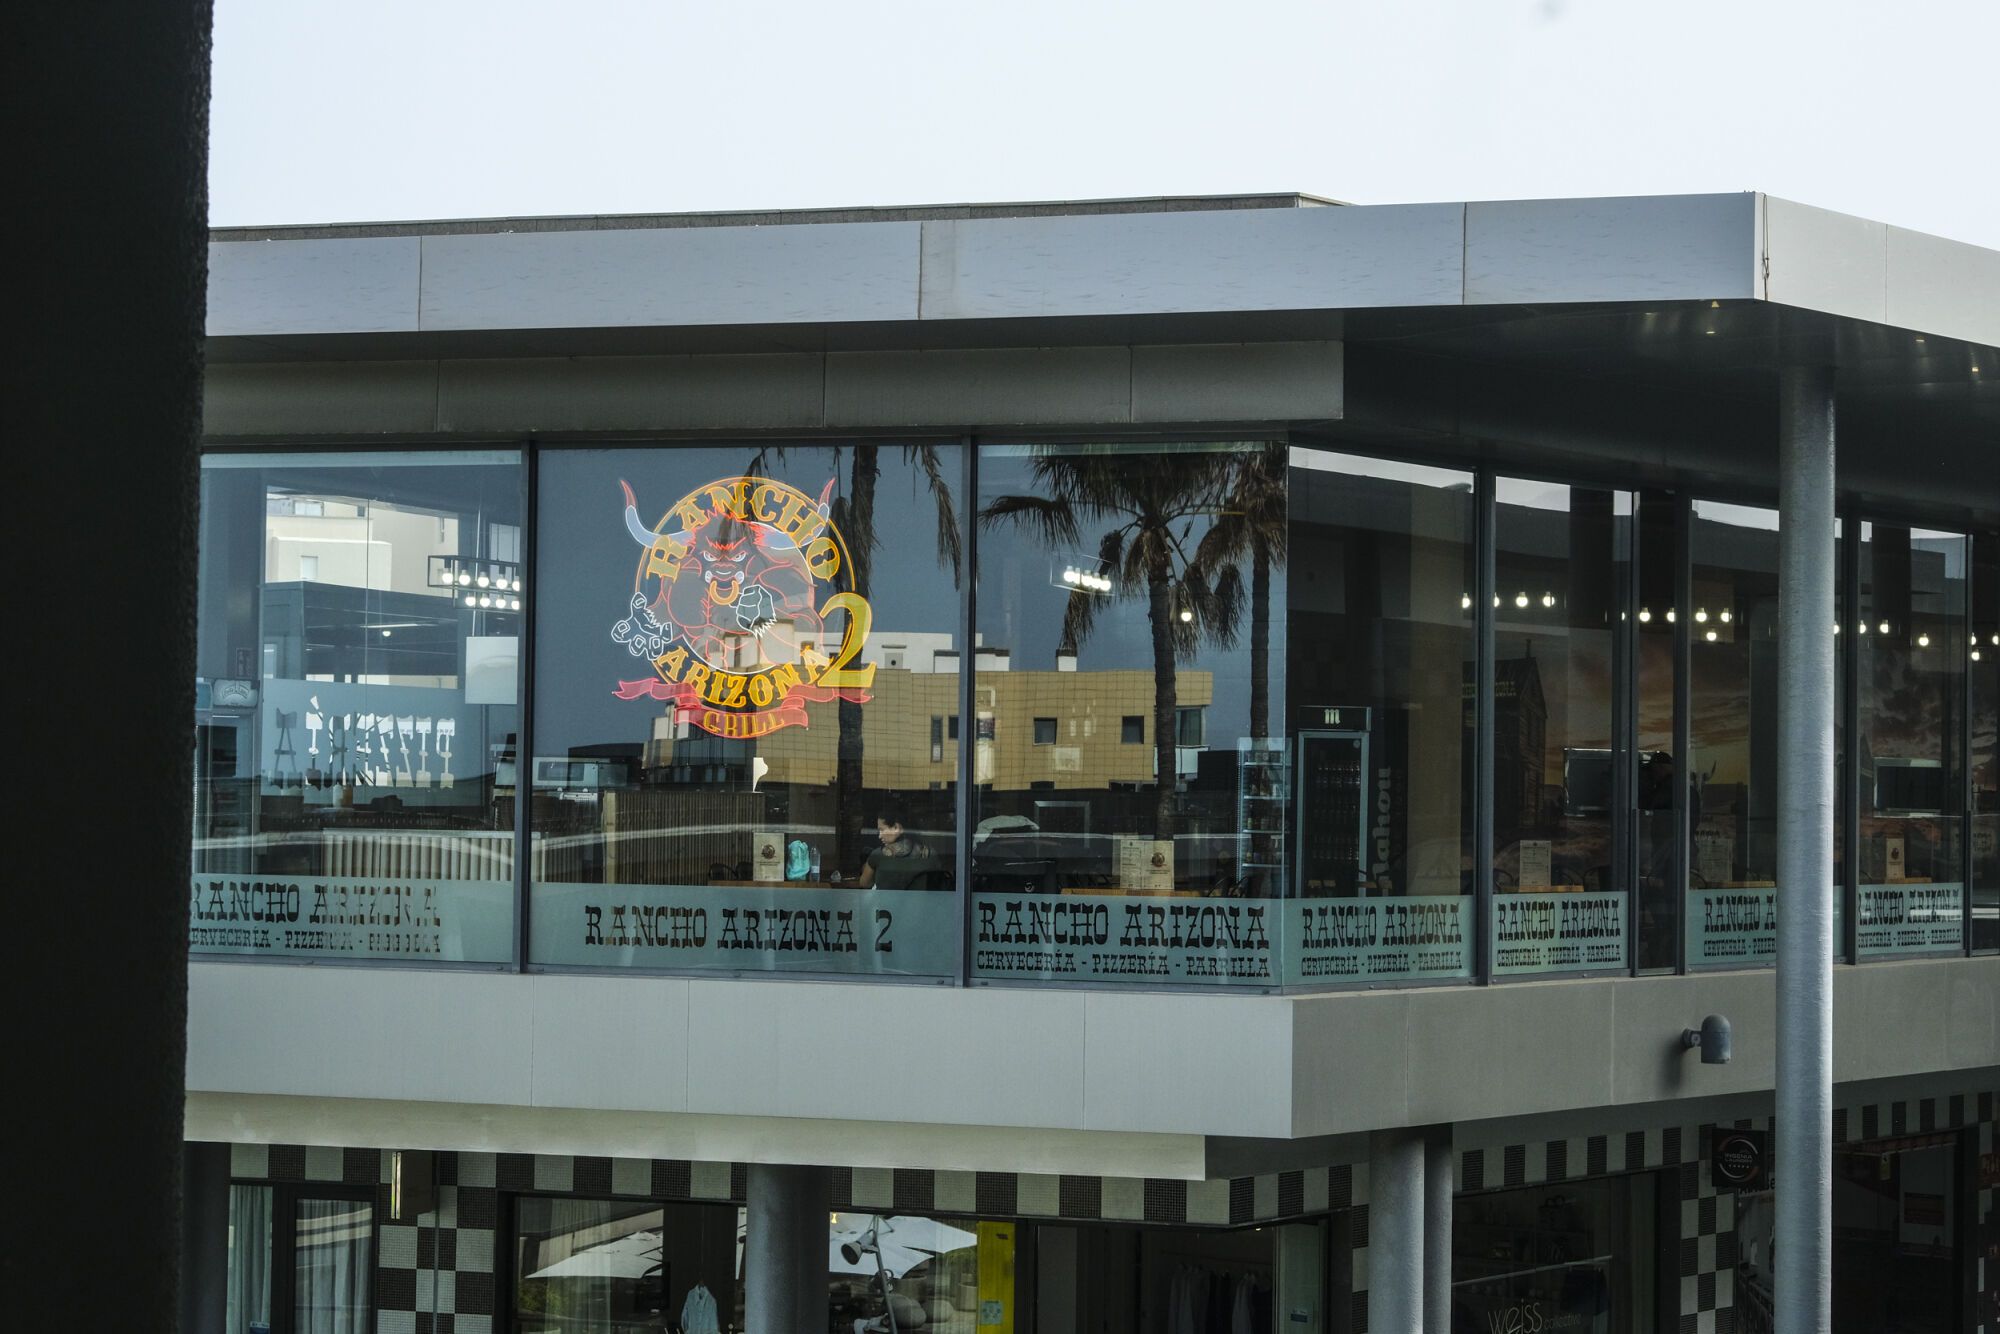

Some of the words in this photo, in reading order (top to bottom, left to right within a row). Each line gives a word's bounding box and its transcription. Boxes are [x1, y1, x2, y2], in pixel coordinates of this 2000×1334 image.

[646, 481, 842, 582] RANCHO
[655, 645, 834, 708] ARIZONA
[815, 592, 877, 688] 2
[703, 711, 785, 737] GRILL
[585, 904, 707, 948] RANCHO
[717, 907, 857, 952] ARIZONA
[875, 909, 893, 952] 2
[978, 900, 1109, 946] RANCHO
[1119, 903, 1270, 950] ARIZONA
[1302, 905, 1377, 949] RANCHO
[1382, 902, 1462, 946] ARIZONA
[1497, 901, 1555, 942] RANCHO
[1559, 899, 1621, 940] ARIZONA
[1703, 895, 1760, 933] RANCHO
[191, 926, 271, 948] ERVECERÍA
[976, 948, 1077, 973] CERVECERÍA
[1091, 951, 1170, 975] PIZZERÍA
[1185, 955, 1271, 978] PARRILLA
[1301, 951, 1358, 977] CERVECERÍA
[1367, 949, 1410, 974] PIZZERÍA
[1418, 951, 1463, 971] PARRILLA
